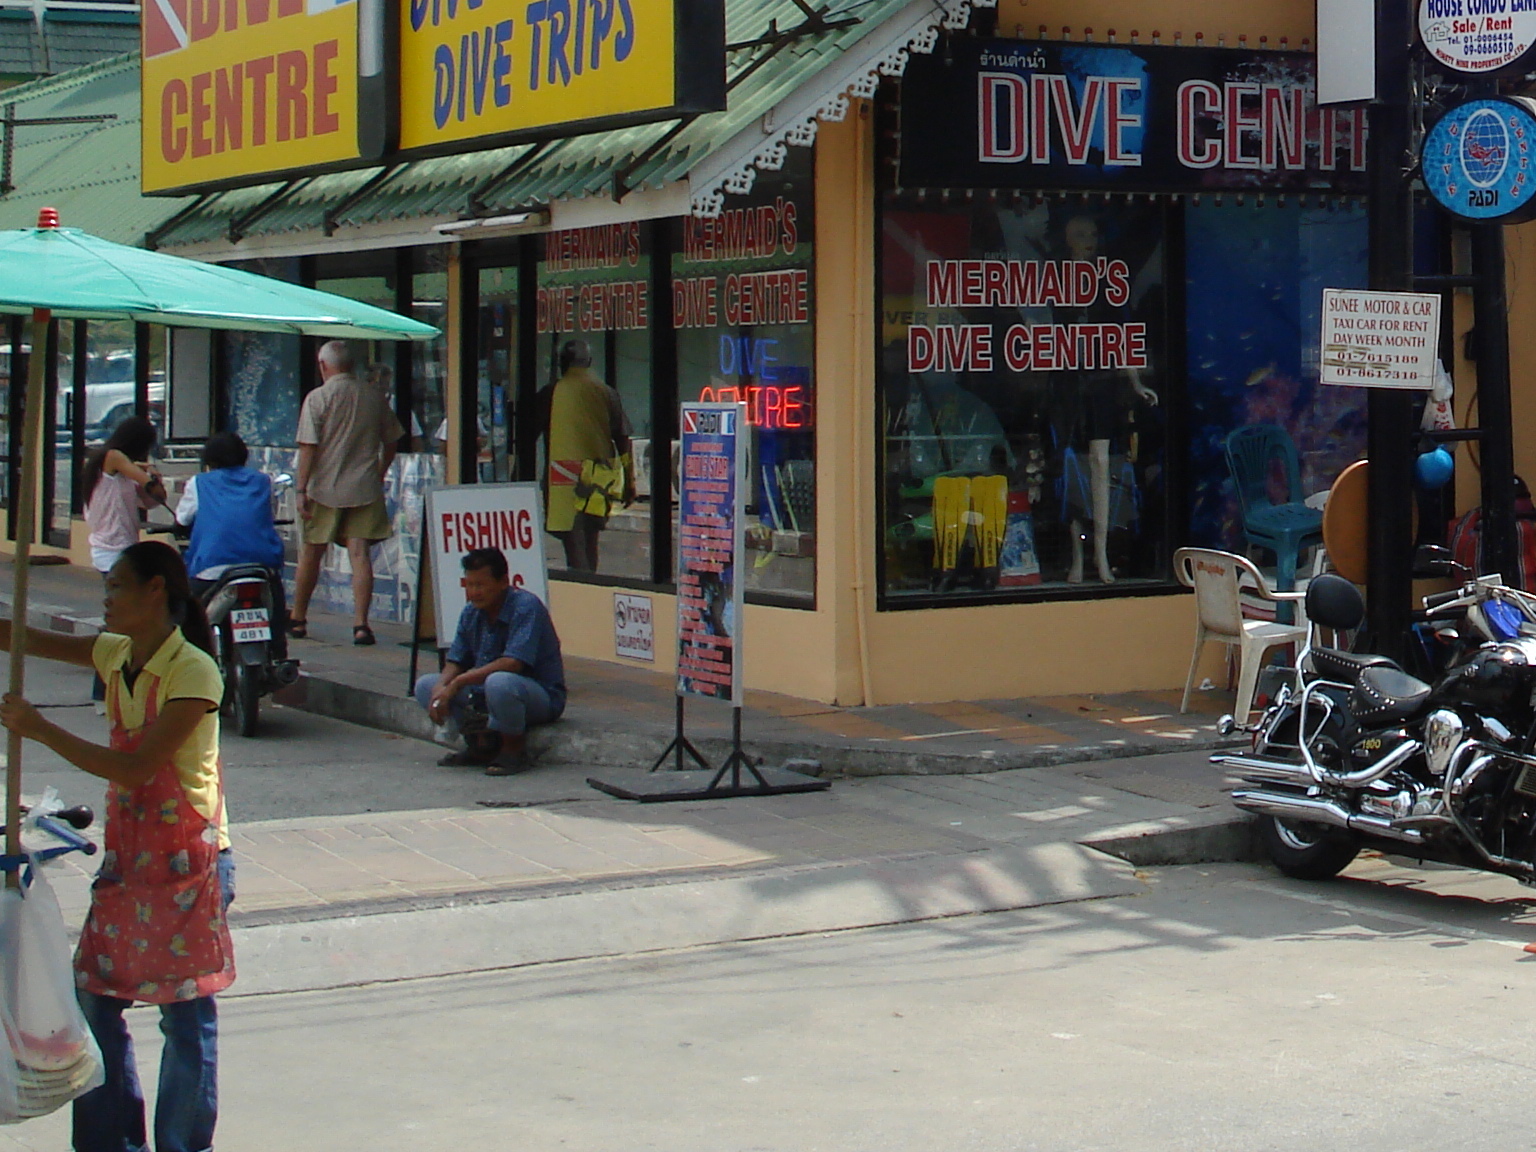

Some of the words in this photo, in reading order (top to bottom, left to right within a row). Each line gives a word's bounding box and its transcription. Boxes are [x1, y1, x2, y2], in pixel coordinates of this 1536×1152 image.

[433, 19, 514, 130] DIVE
[161, 39, 339, 164] CENTRE
[977, 71, 1142, 167] DIVE
[1468, 190, 1498, 207] PADI
[683, 196, 797, 263] MERMAID'S
[537, 285, 574, 333] DIVE
[579, 281, 647, 332] CENTRE
[673, 276, 717, 329] DIVE
[724, 269, 808, 327] CENTRE
[926, 256, 1129, 308] MERMAID'S
[1329, 298, 1359, 313] SUNEE
[1364, 299, 1401, 315] MOTOR
[1403, 302, 1410, 315] &
[1412, 301, 1431, 316] CAR
[908, 324, 993, 373] DIVE
[1004, 322, 1147, 373] CENTRE
[1333, 318, 1354, 329] TAXI
[1357, 319, 1377, 330] CAR
[1379, 320, 1400, 331] FOR
[1403, 321, 1428, 332] RENT
[1333, 333, 1353, 344] DAY
[1355, 334, 1382, 346] WEEK
[1385, 336, 1425, 347] MONTH
[719, 334, 779, 381] DIVE
[442, 509, 533, 554] FISHING
